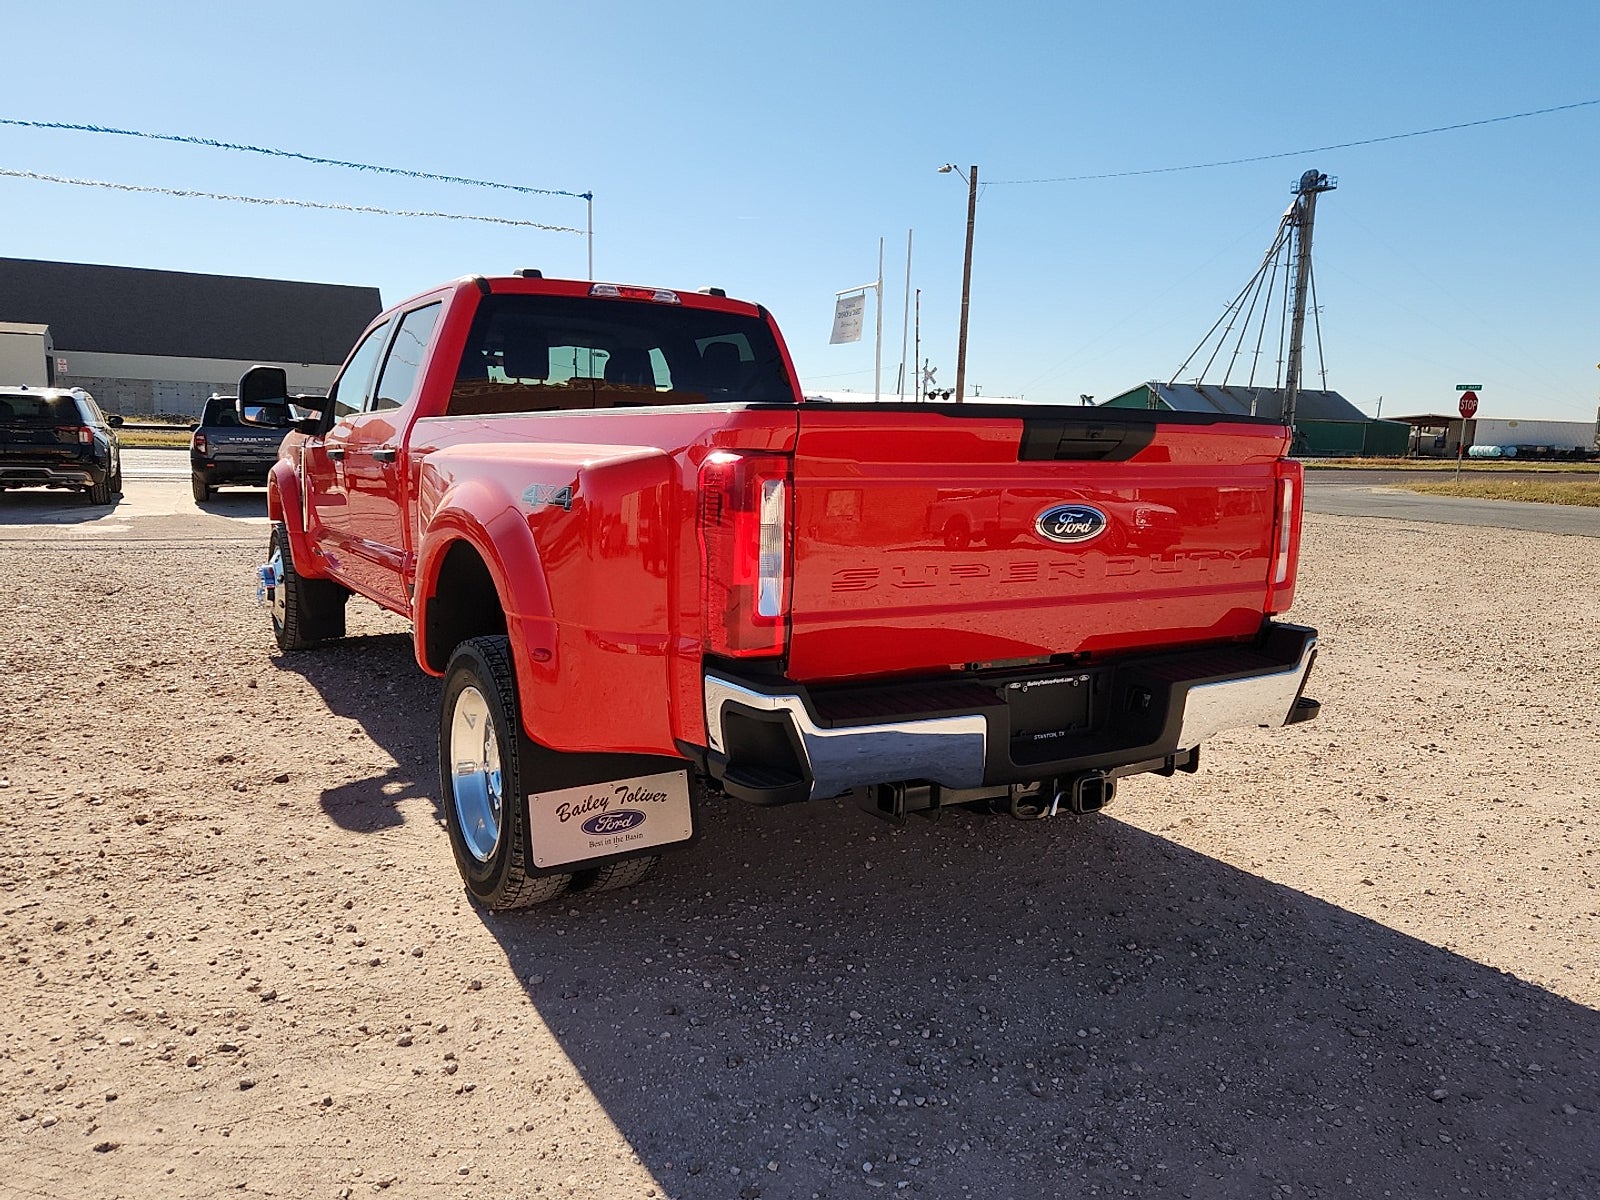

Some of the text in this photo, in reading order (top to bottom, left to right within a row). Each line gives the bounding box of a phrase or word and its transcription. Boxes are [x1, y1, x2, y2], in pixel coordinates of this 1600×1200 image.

[1460, 399, 1477, 410] STOP
[1054, 512, 1092, 534] Ford
[831, 549, 1254, 592] SUPER DUTY
[556, 785, 668, 823] Bailey Toliver
[594, 813, 633, 832] Ford
[588, 832, 644, 848] Best in the Basin
